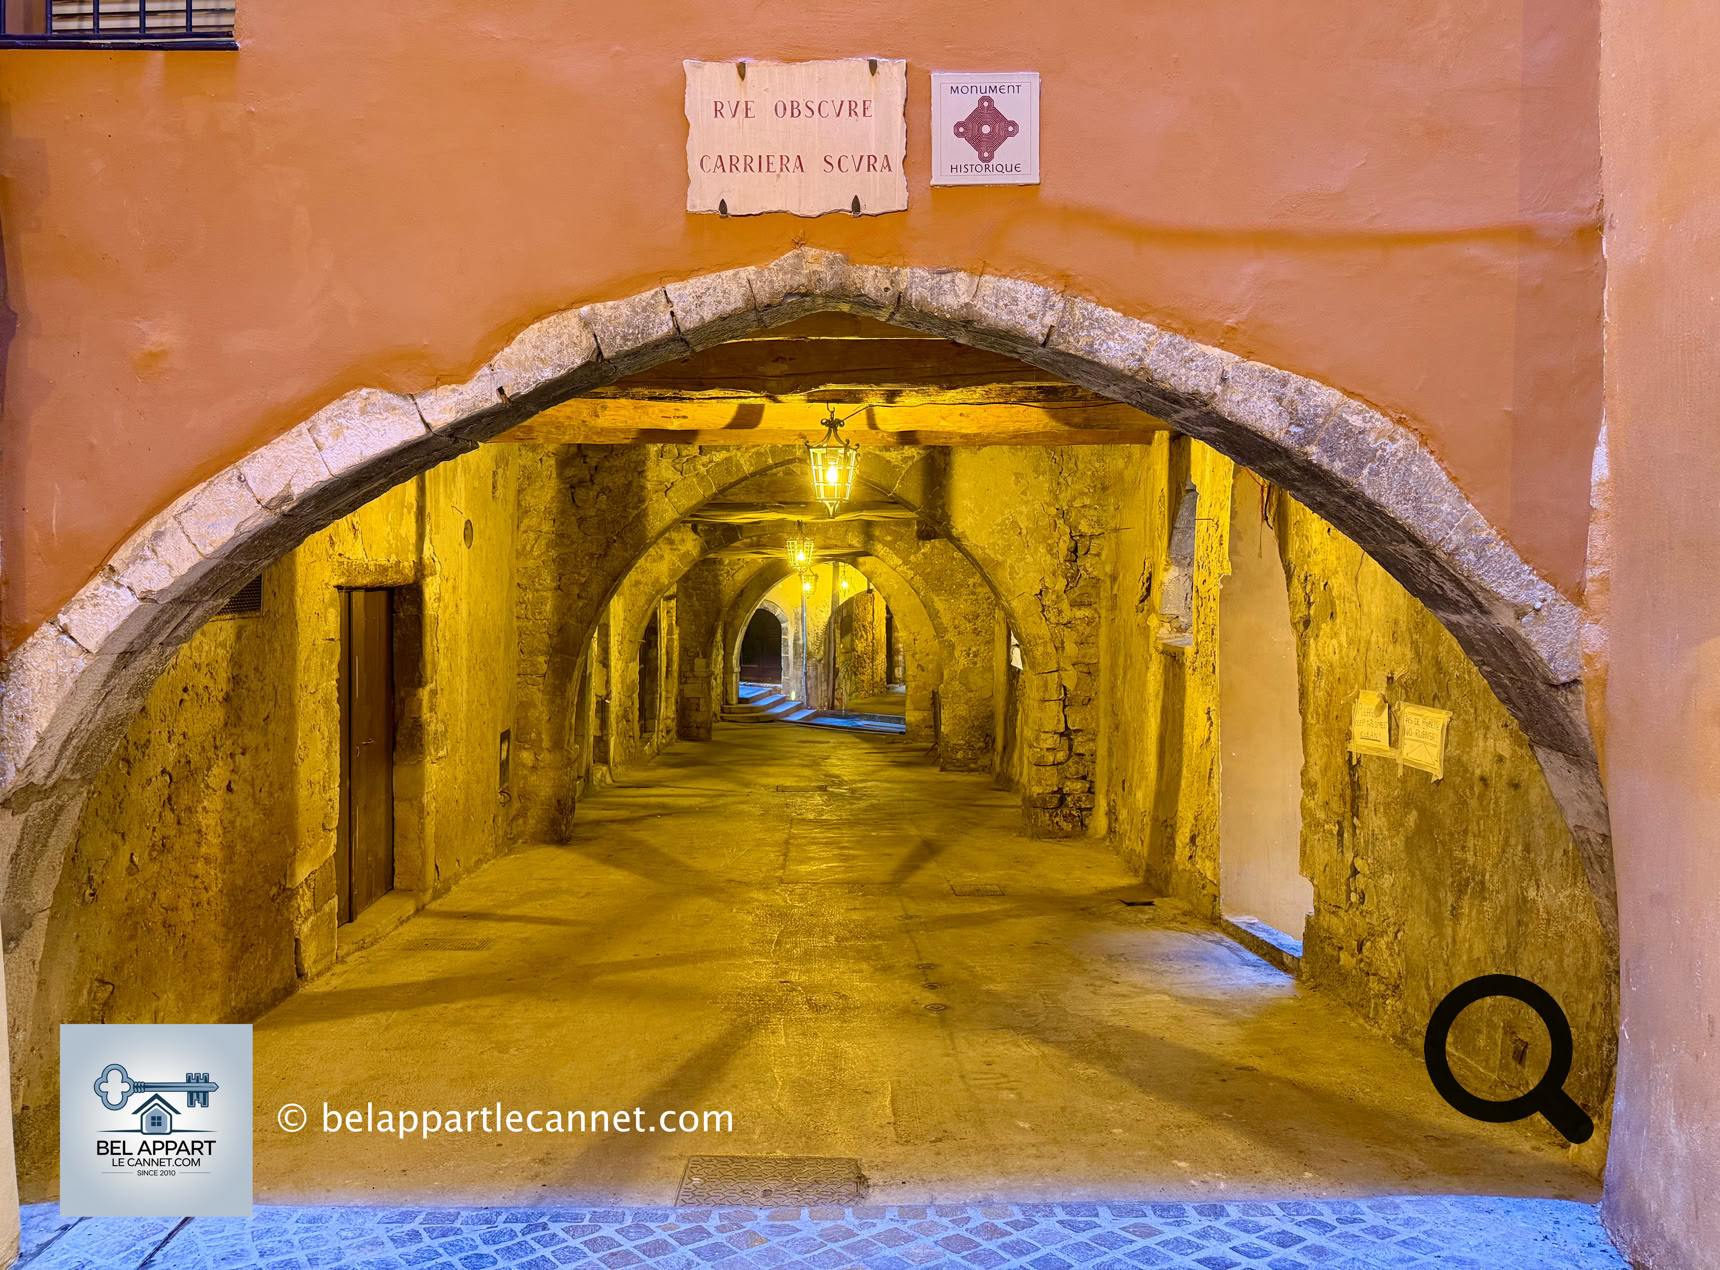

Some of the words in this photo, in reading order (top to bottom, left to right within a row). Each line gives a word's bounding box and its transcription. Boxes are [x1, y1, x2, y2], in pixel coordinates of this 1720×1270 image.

[950, 84, 1022, 95] MONUMENT
[700, 155, 804, 173] CARRIERA
[950, 162, 1022, 174] HISTORIQUE
